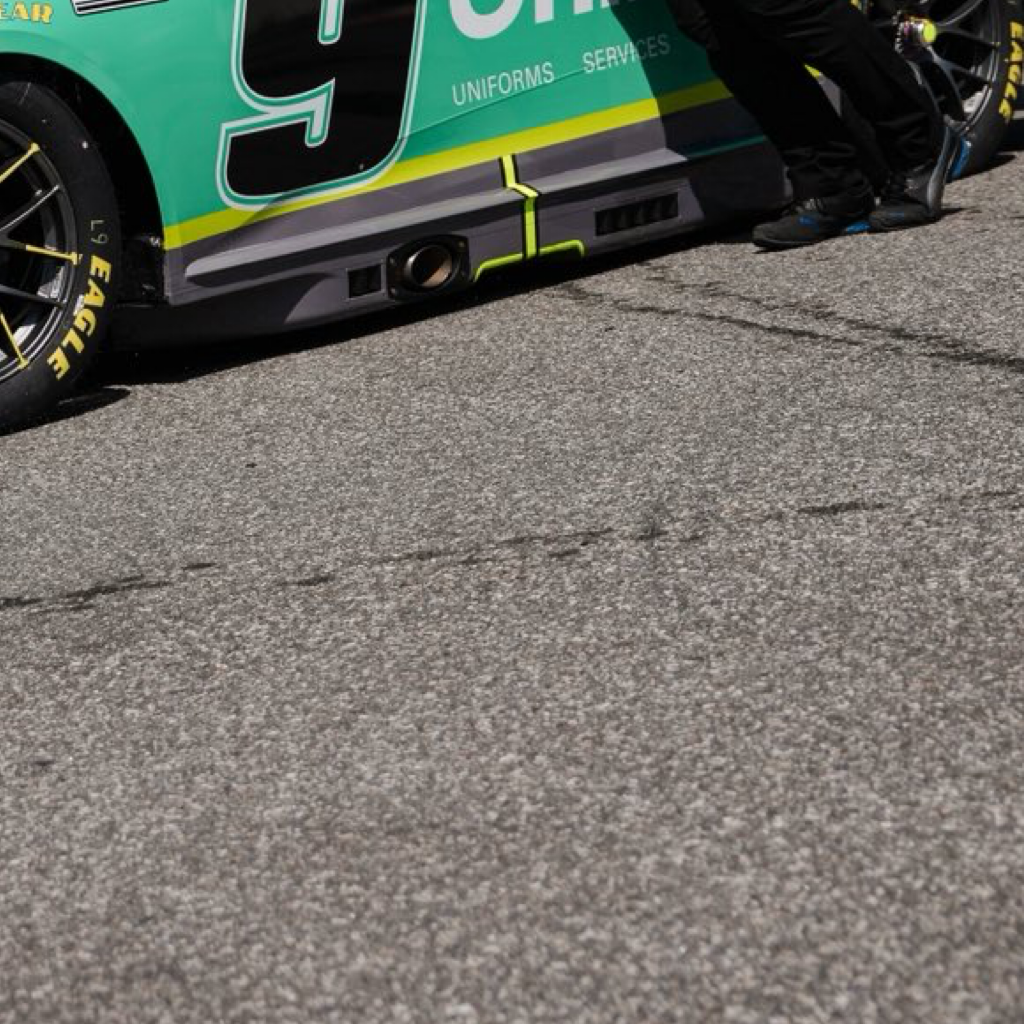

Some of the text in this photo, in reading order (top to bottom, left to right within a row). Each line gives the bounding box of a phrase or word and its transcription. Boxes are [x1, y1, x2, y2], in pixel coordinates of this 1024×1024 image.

[451, 33, 671, 106] UNIFORMS SERVICES
[47, 254, 112, 380] EAGLE
